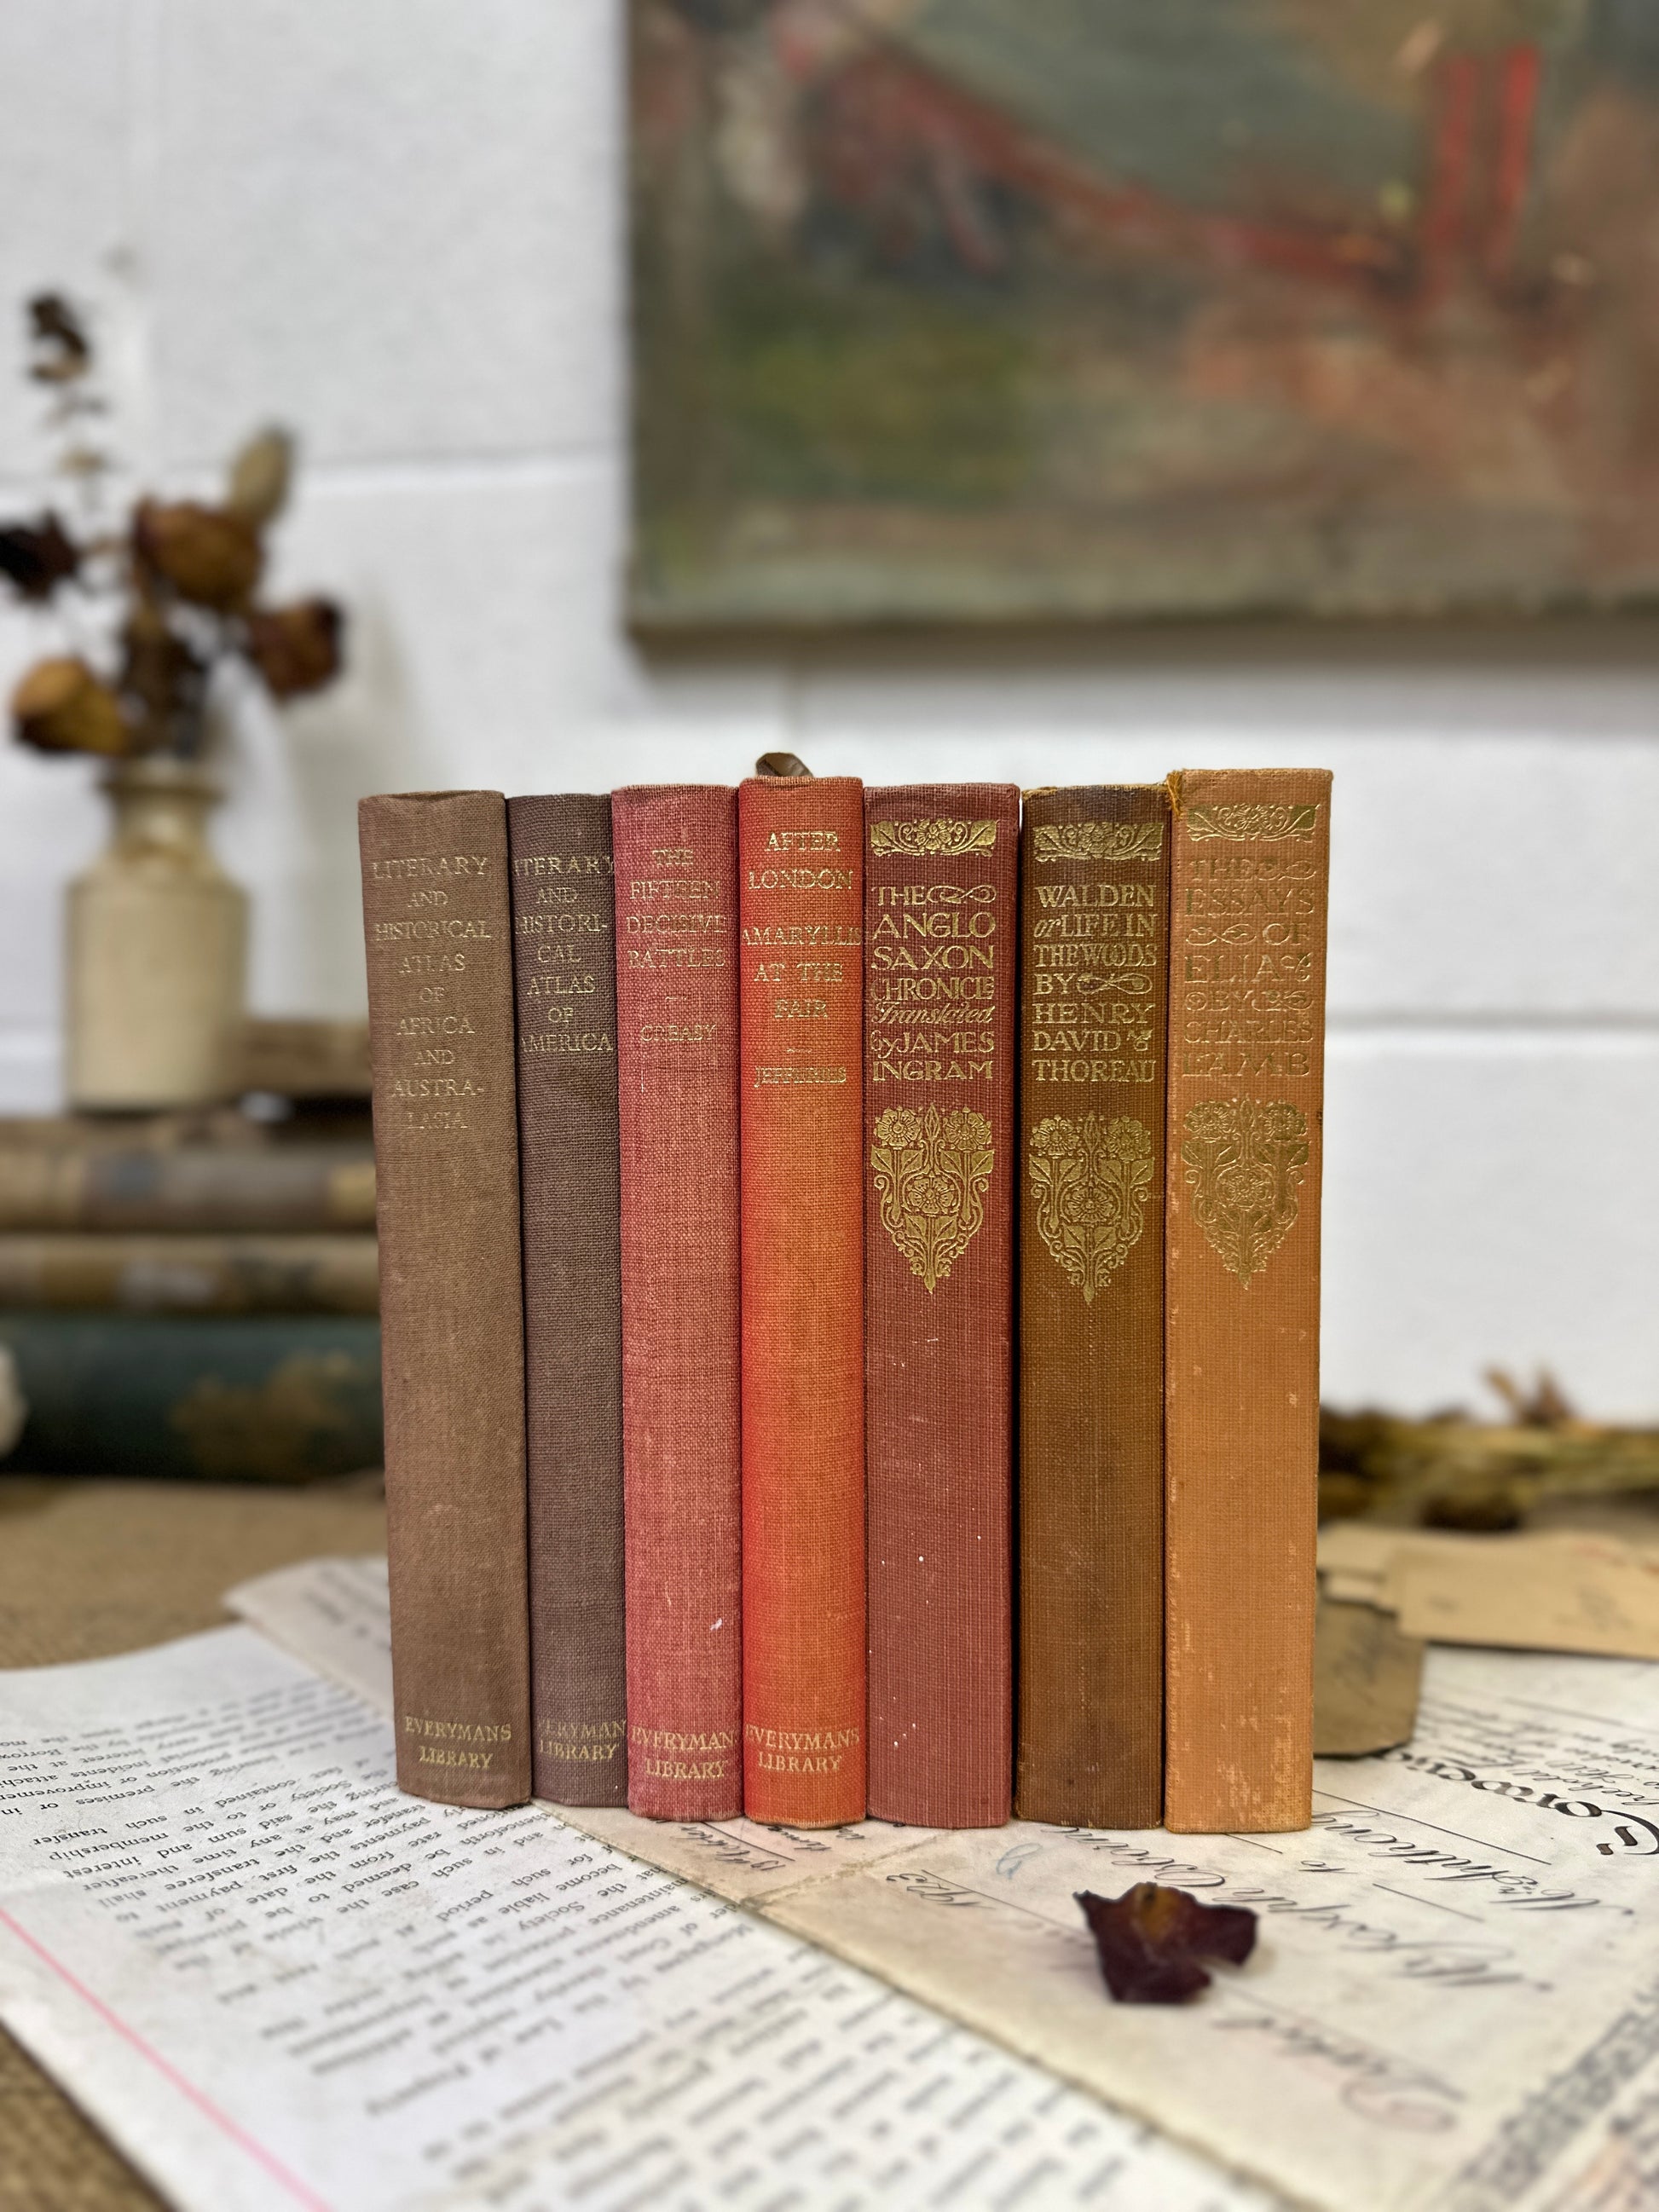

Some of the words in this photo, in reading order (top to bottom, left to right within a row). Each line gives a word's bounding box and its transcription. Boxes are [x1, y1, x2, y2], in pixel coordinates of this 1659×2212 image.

[764, 831, 841, 852] AFTER
[372, 856, 488, 878] LITERARY
[652, 849, 694, 866] THE
[749, 869, 853, 890] LONDON
[1189, 858, 1253, 881] THE
[408, 891, 448, 908] AND
[535, 887, 579, 904] AND
[629, 880, 720, 900] FIFTEEN
[871, 886, 927, 906] THE
[1034, 885, 1157, 908] WALDEN
[1184, 888, 1315, 917] ESSAYS
[374, 920, 491, 940] HISTORICAL
[872, 912, 997, 939] ANGLO
[1060, 914, 1119, 937] LIFE
[1124, 914, 1158, 937] IN
[1262, 923, 1311, 946] OF
[538, 944, 581, 963] CAL
[627, 948, 725, 968] BATTLES
[871, 944, 994, 970] SAXON
[754, 963, 785, 982] AT
[796, 963, 843, 982] THE
[419, 986, 445, 1002] OF
[527, 976, 595, 995] ATLAS
[1032, 973, 1077, 995] BY
[548, 1008, 574, 1024] OF
[774, 999, 829, 1018] FAIR
[870, 1001, 996, 1025] Translated
[1032, 1003, 1156, 1024] HENRY
[396, 1016, 475, 1035] AFRICA
[1183, 1020, 1314, 1044] CHARLES
[521, 1033, 613, 1054] AMERICA
[897, 1031, 994, 1054] JAMES
[1032, 1030, 1122, 1052] DAVID
[414, 1049, 455, 1066] AND
[1182, 1052, 1311, 1077] LAMB
[872, 1060, 993, 1082] INGRAM
[1032, 1060, 1157, 1083] THOREAU
[419, 1745, 494, 1769] LIBRARY
[539, 1740, 621, 1761] LIBRARY
[645, 1758, 728, 1779] LIBRARY
[758, 1751, 842, 1773] LIBRARY
[75, 1785, 155, 1805] premises
[214, 1780, 297, 1808] contained
[290, 1780, 352, 1804] Society
[183, 1806, 203, 1816] in
[226, 1811, 246, 1822] to
[259, 1802, 277, 1812] or
[306, 1799, 338, 1815] the
[363, 1804, 425, 1828] transfer
[125, 1815, 168, 1829] such
[182, 1820, 214, 1834] the
[257, 1814, 293, 1830] said
[294, 1823, 315, 1834] at
[323, 1810, 359, 1827] may
[32, 1828, 108, 1846] transfer
[207, 1828, 247, 1844] sum
[249, 1833, 283, 1849] any
[320, 1828, 353, 1845] and
[350, 1816, 431, 1851] payments
[407, 1831, 442, 1849] rate
[512, 1831, 544, 1847] and
[49, 1832, 169, 1863] membership
[156, 1843, 193, 1859] and
[192, 1848, 237, 1865] time
[274, 1843, 306, 1858] the
[309, 1850, 340, 1865] the
[425, 1847, 451, 1862] be
[483, 1845, 506, 1857] in
[62, 1856, 142, 1879] interest
[349, 1851, 395, 1870] from
[431, 1857, 473, 1880] such
[565, 1852, 594, 1868] for
[83, 1864, 179, 1891] thereafter
[165, 1858, 260, 1891] transferee
[257, 1864, 298, 1883] first
[304, 1870, 337, 1886] the
[340, 1862, 412, 1894] deemed
[511, 1868, 551, 1889] such
[555, 1863, 623, 1894] become
[155, 1880, 243, 1914] payment
[246, 1886, 288, 1906] date
[308, 1892, 330, 1904] to
[380, 1880, 419, 1897] case
[597, 1882, 627, 1899] the
[97, 1890, 147, 1909] shall
[436, 1889, 494, 1924] period
[498, 1891, 551, 1917] liable
[517, 1900, 586, 1932] Society
